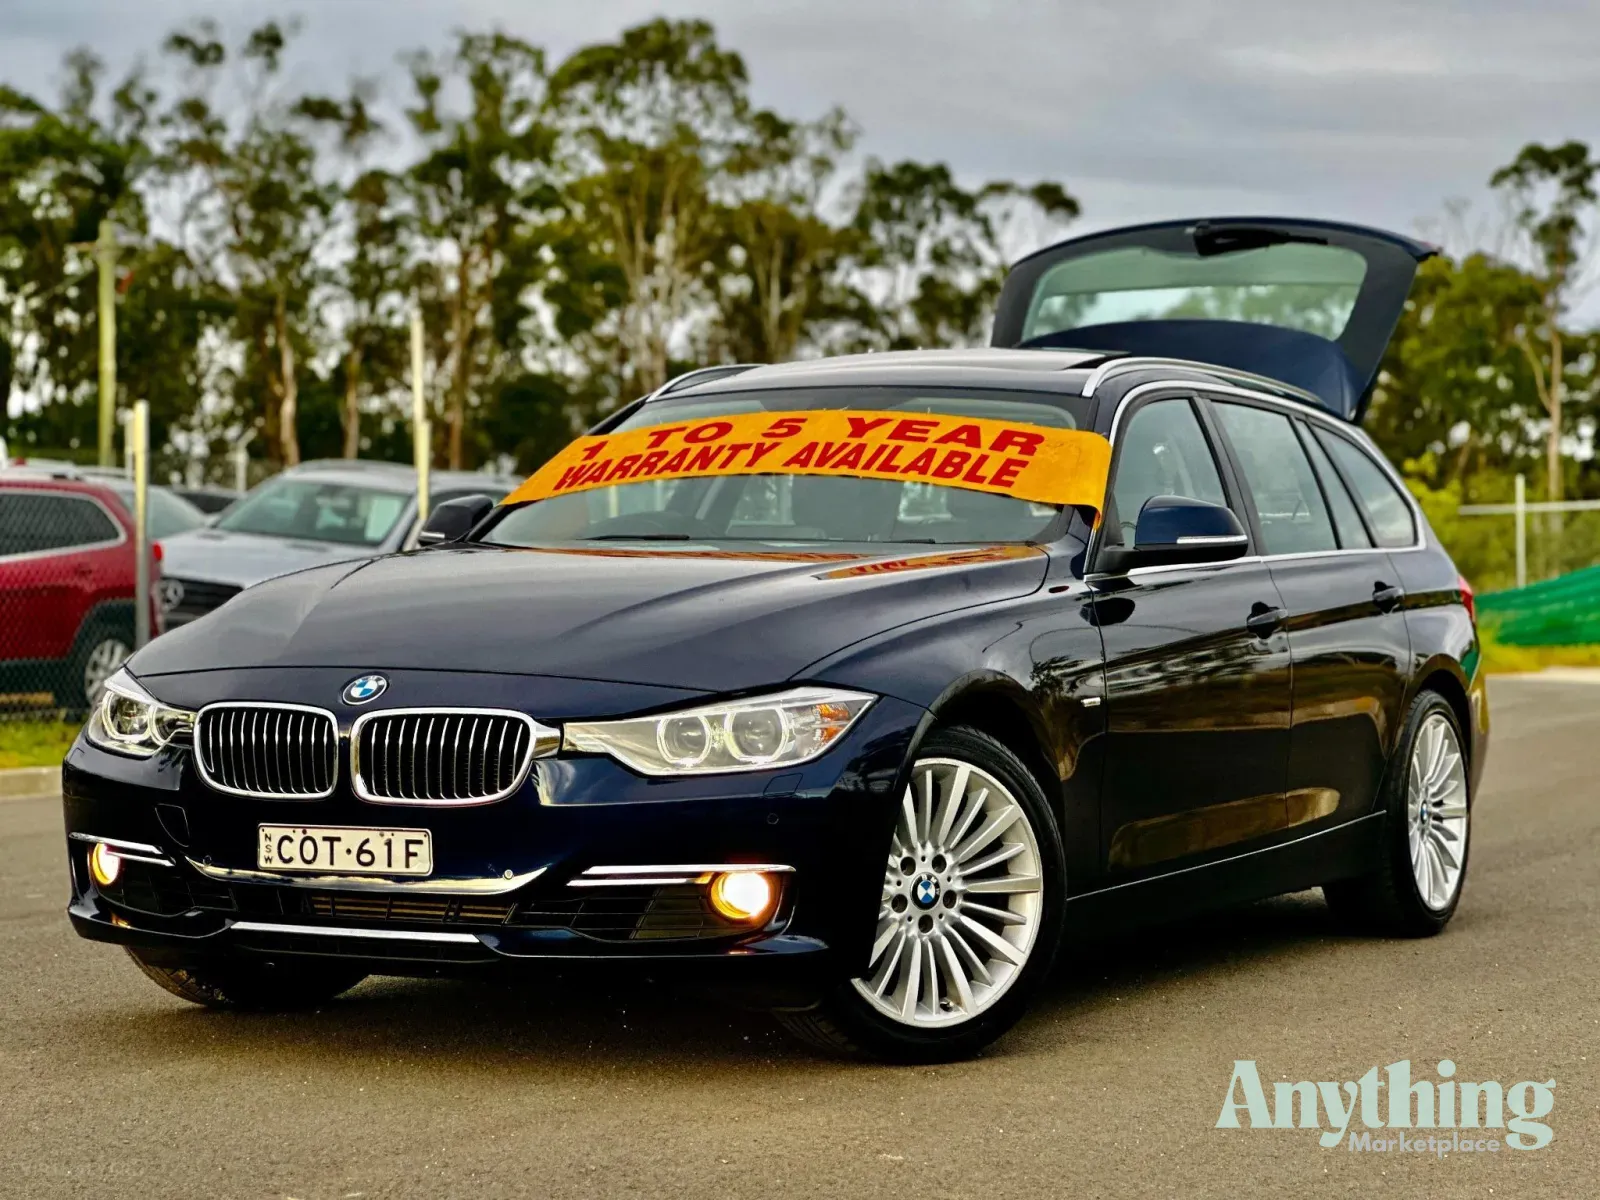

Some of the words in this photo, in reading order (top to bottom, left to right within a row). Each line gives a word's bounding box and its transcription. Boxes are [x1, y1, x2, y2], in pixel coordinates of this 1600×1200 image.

[582, 440, 608, 462] 1
[646, 421, 734, 450] TO
[761, 417, 808, 439] 5
[847, 417, 1045, 457] YEAR
[552, 441, 782, 491] WARRANTY
[782, 441, 1030, 488] AVAILABLE
